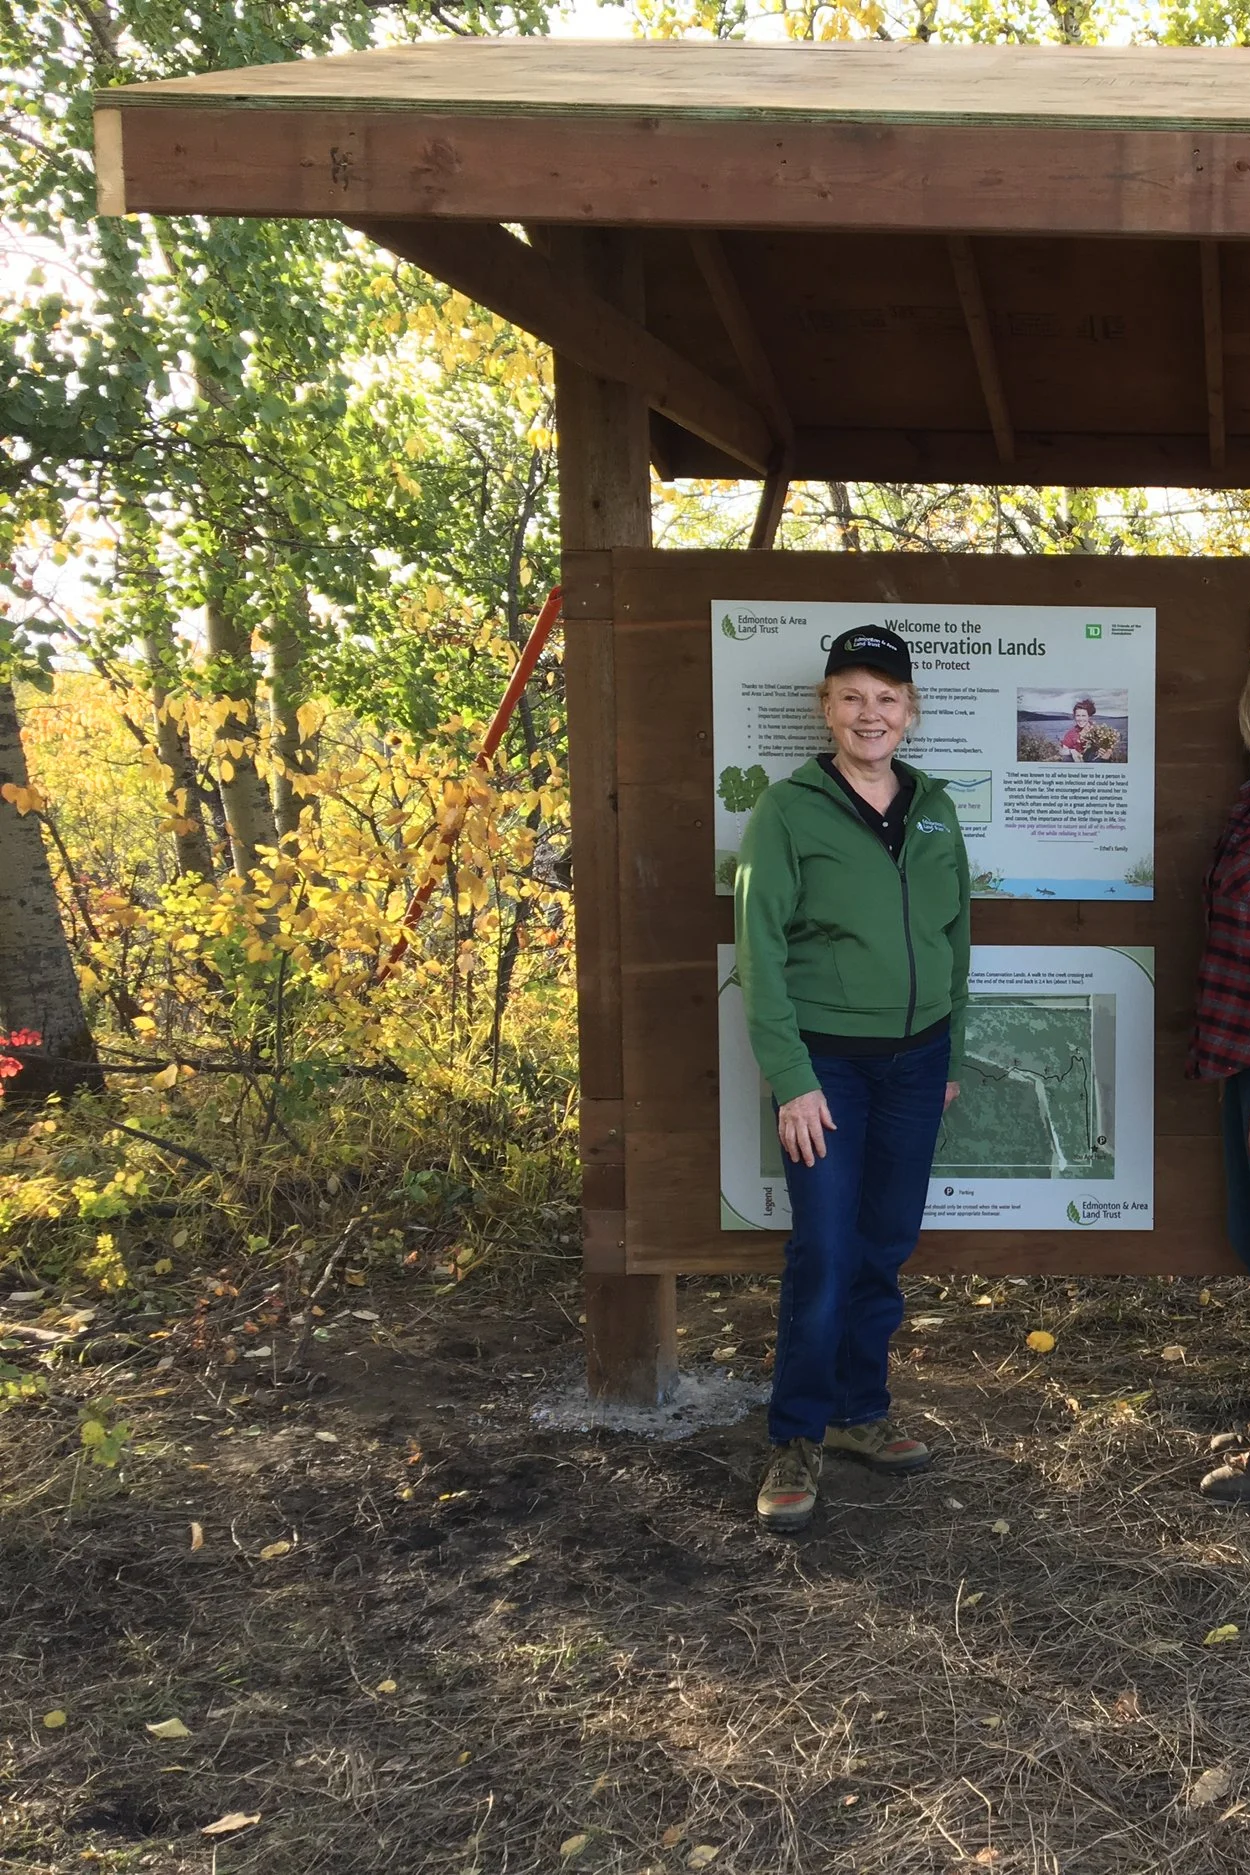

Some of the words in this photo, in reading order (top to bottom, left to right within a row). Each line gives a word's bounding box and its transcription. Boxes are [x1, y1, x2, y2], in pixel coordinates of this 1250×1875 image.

[738, 615, 778, 624] Edmonton
[780, 616, 786, 624] &
[789, 616, 807, 625] Area
[760, 625, 778, 633] Trust
[885, 619, 940, 632] Welcome
[945, 622, 957, 633] to
[962, 620, 981, 633] the
[907, 639, 992, 655] nservation
[998, 638, 1046, 656] Lands
[922, 661, 932, 670] to
[935, 660, 970, 670] Protect
[763, 1187, 775, 1216] Legend
[1082, 1201, 1120, 1210] Edmonton
